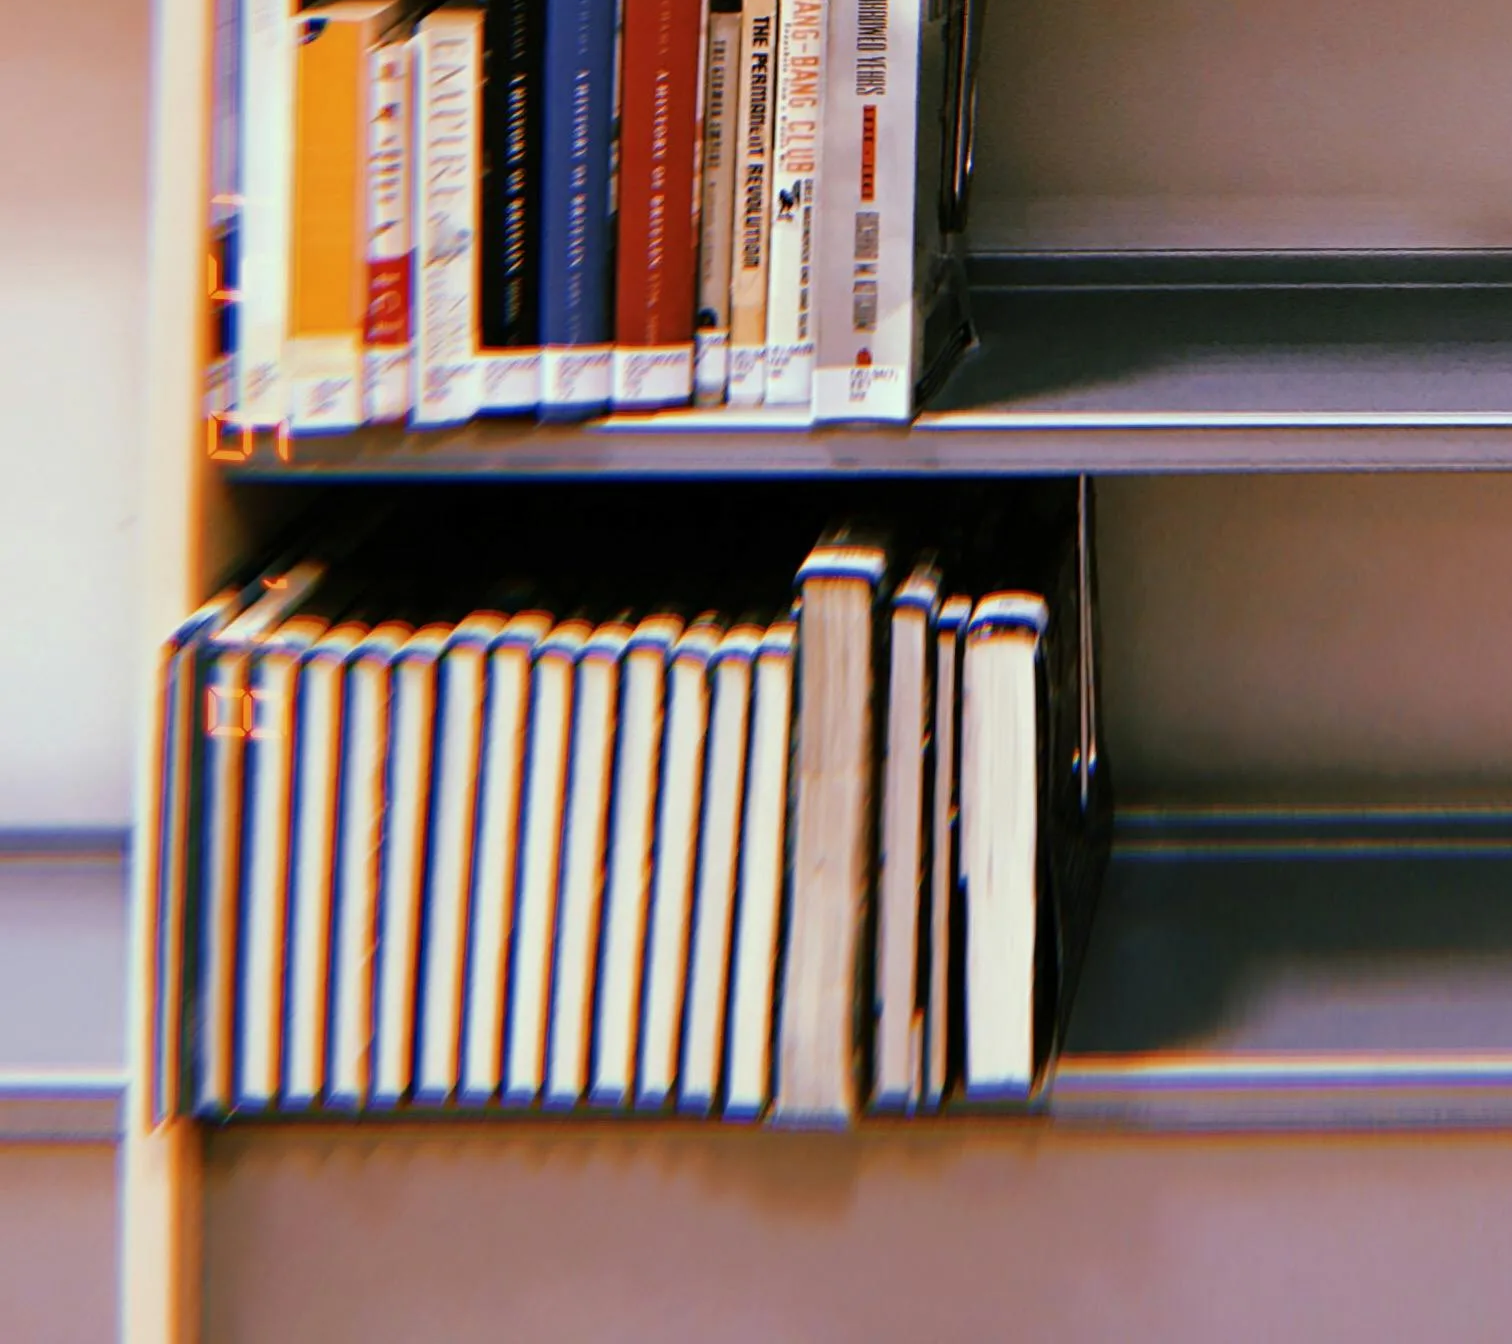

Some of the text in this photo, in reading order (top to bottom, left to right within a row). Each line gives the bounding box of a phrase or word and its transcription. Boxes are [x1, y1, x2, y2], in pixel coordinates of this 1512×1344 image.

[751, 16, 771, 48] THE
[854, 56, 886, 96] YEARS
[651, 83, 669, 160] HISTORY
[786, 120, 815, 175] CLUB
[650, 165, 666, 189] OF
[647, 195, 667, 269] BRITAIN
